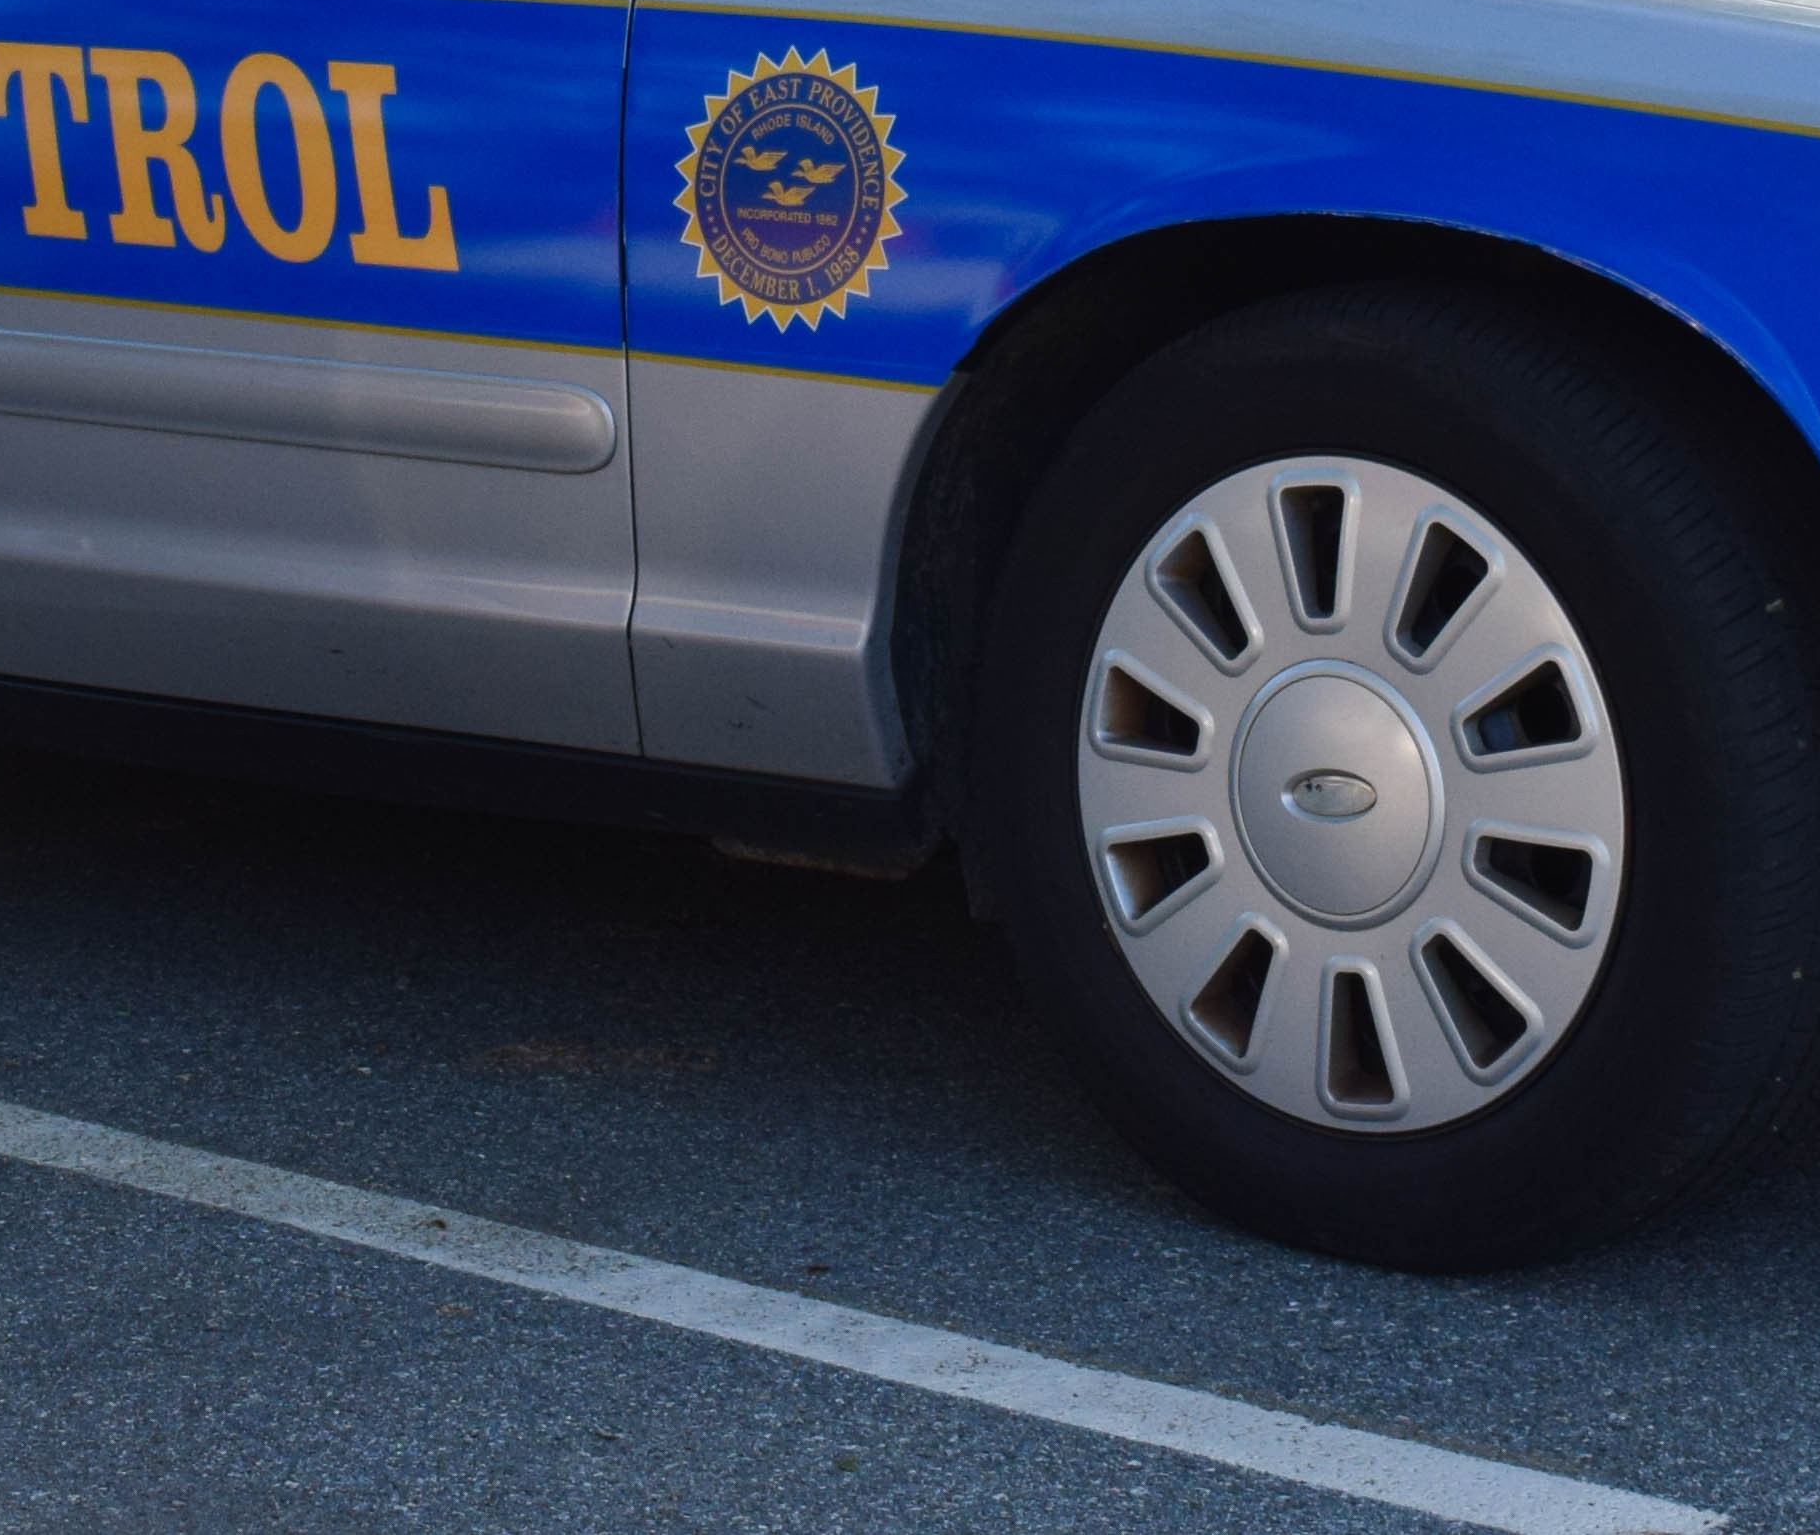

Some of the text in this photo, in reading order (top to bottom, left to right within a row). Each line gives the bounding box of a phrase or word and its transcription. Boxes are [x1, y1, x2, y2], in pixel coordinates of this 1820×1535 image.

[699, 78, 880, 210] CITY OF EAST PROVIDENCE
[751, 114, 835, 145] RHODE ISLAND
[737, 207, 811, 224] INCORPORATED
[712, 235, 861, 300] DECEMBER 1, 1958
